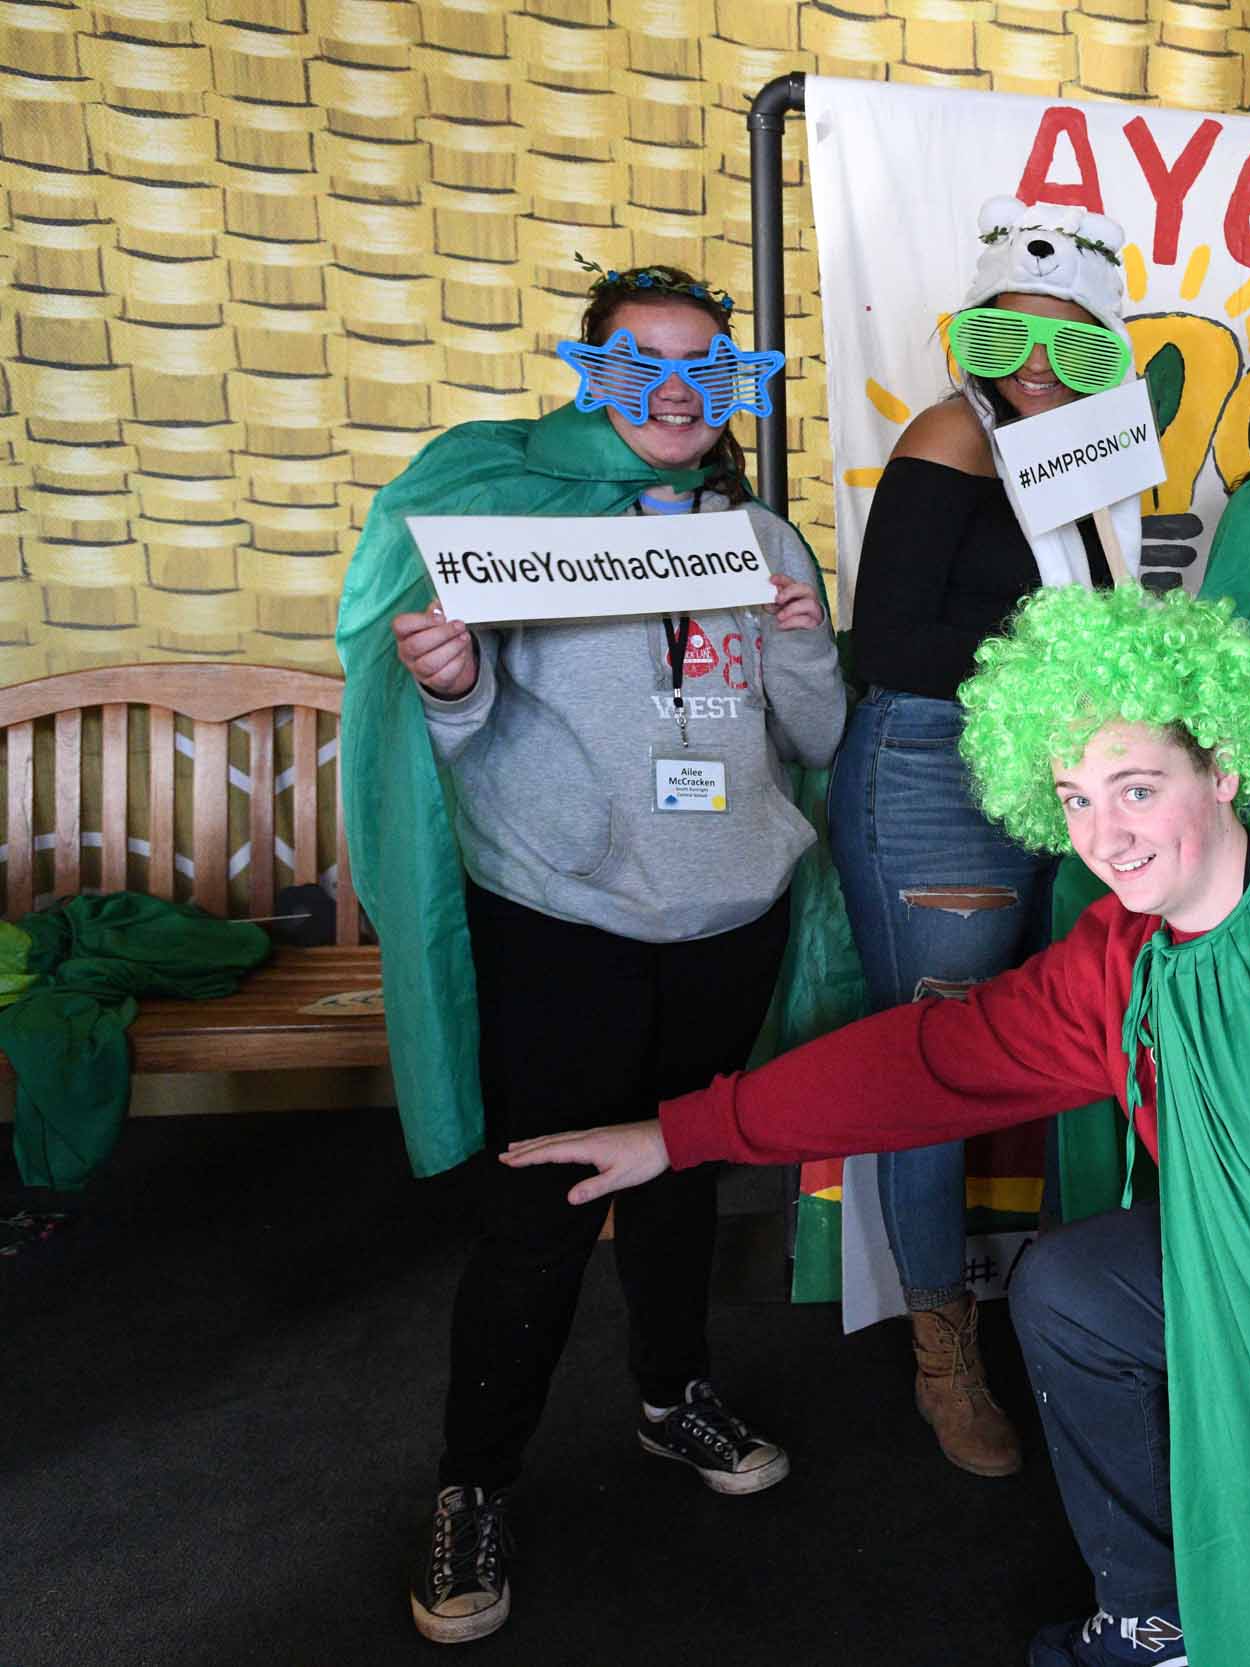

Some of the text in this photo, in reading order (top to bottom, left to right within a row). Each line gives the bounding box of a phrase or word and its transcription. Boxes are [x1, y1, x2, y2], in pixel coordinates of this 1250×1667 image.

[1018, 424, 1147, 488] #IAMPROSNOW
[435, 548, 760, 585] #GiveYouthaChance
[651, 695, 741, 719] WEST
[668, 777, 715, 787] McCracken
[681, 768, 703, 776] Ailee
